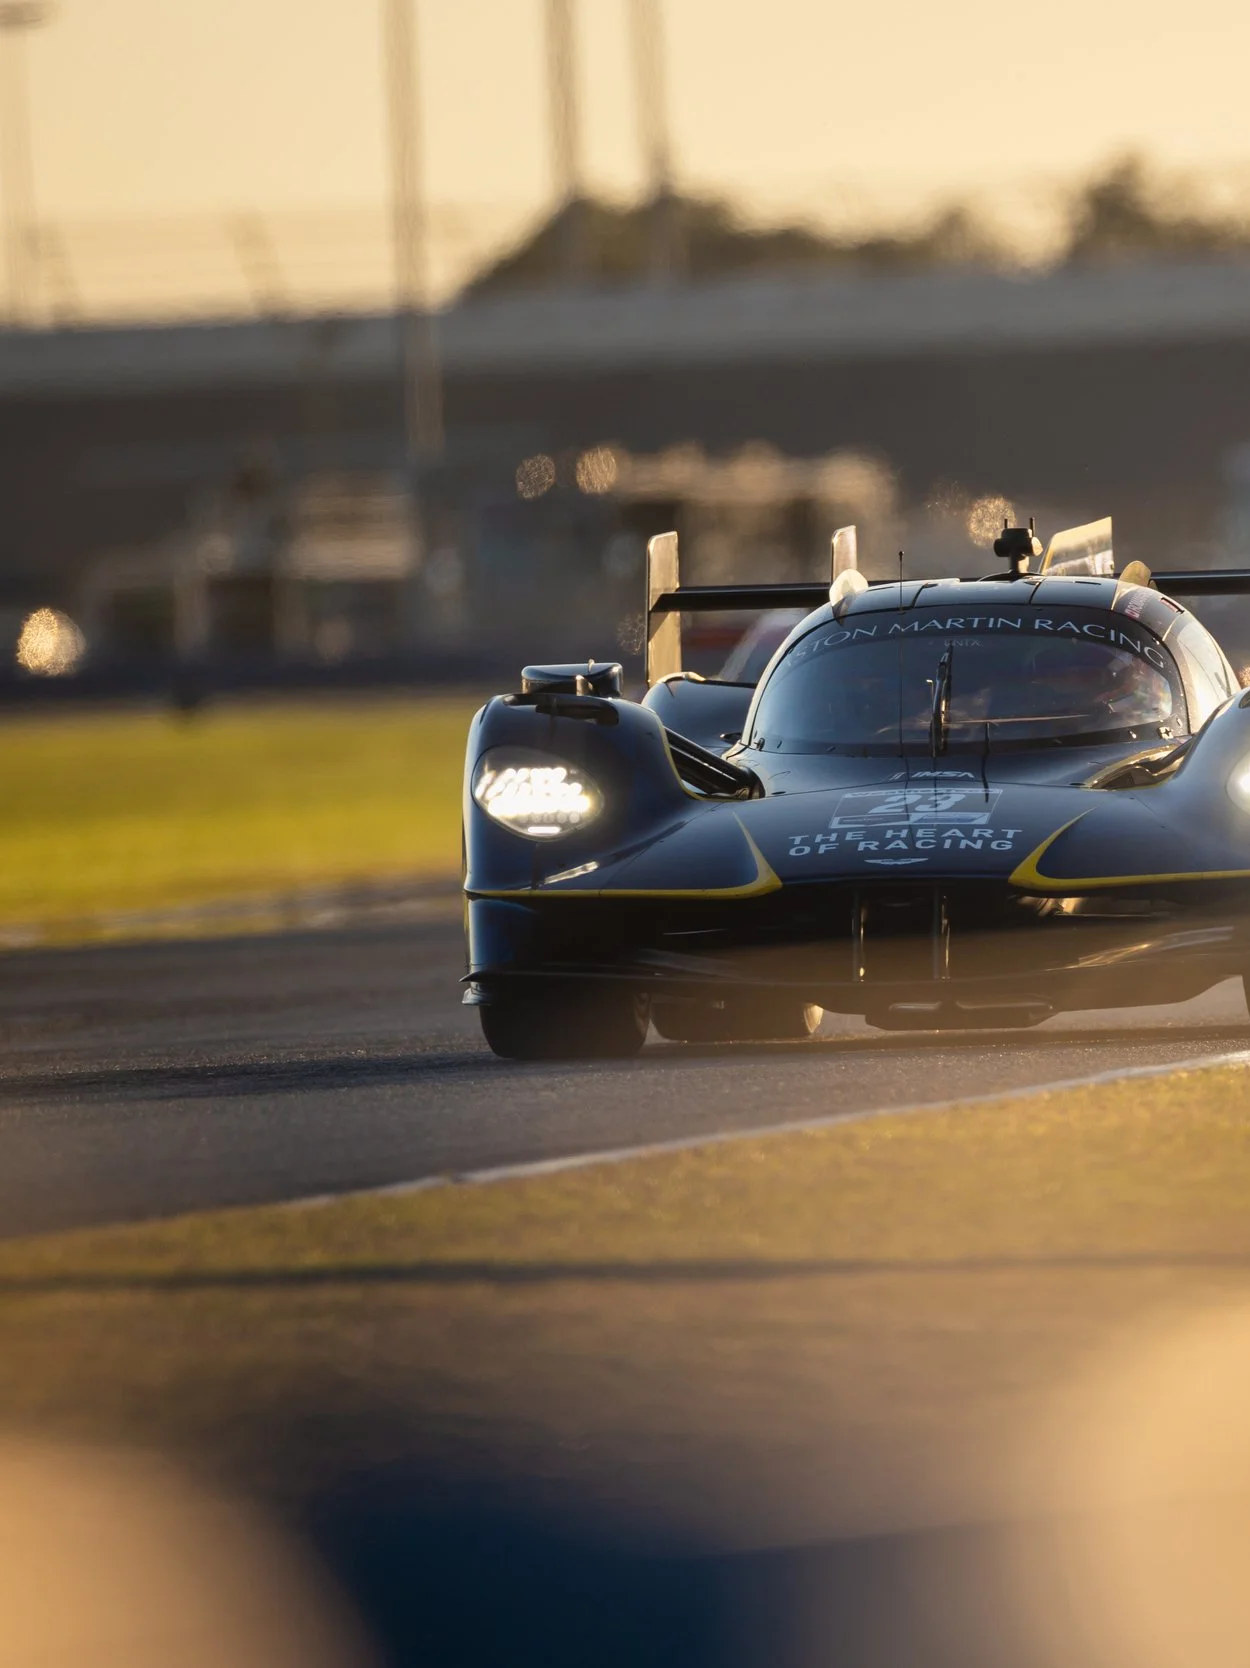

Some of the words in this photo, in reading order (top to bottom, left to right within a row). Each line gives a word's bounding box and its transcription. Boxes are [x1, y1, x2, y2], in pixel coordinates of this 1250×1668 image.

[785, 625, 877, 667] STON
[888, 617, 1022, 634] MARTIN
[1034, 618, 1164, 668] RACING
[868, 793, 966, 814] 23
[788, 831, 867, 845] THE
[885, 828, 1023, 839] HEART
[788, 843, 840, 856] OF
[857, 838, 1013, 851] RACING
